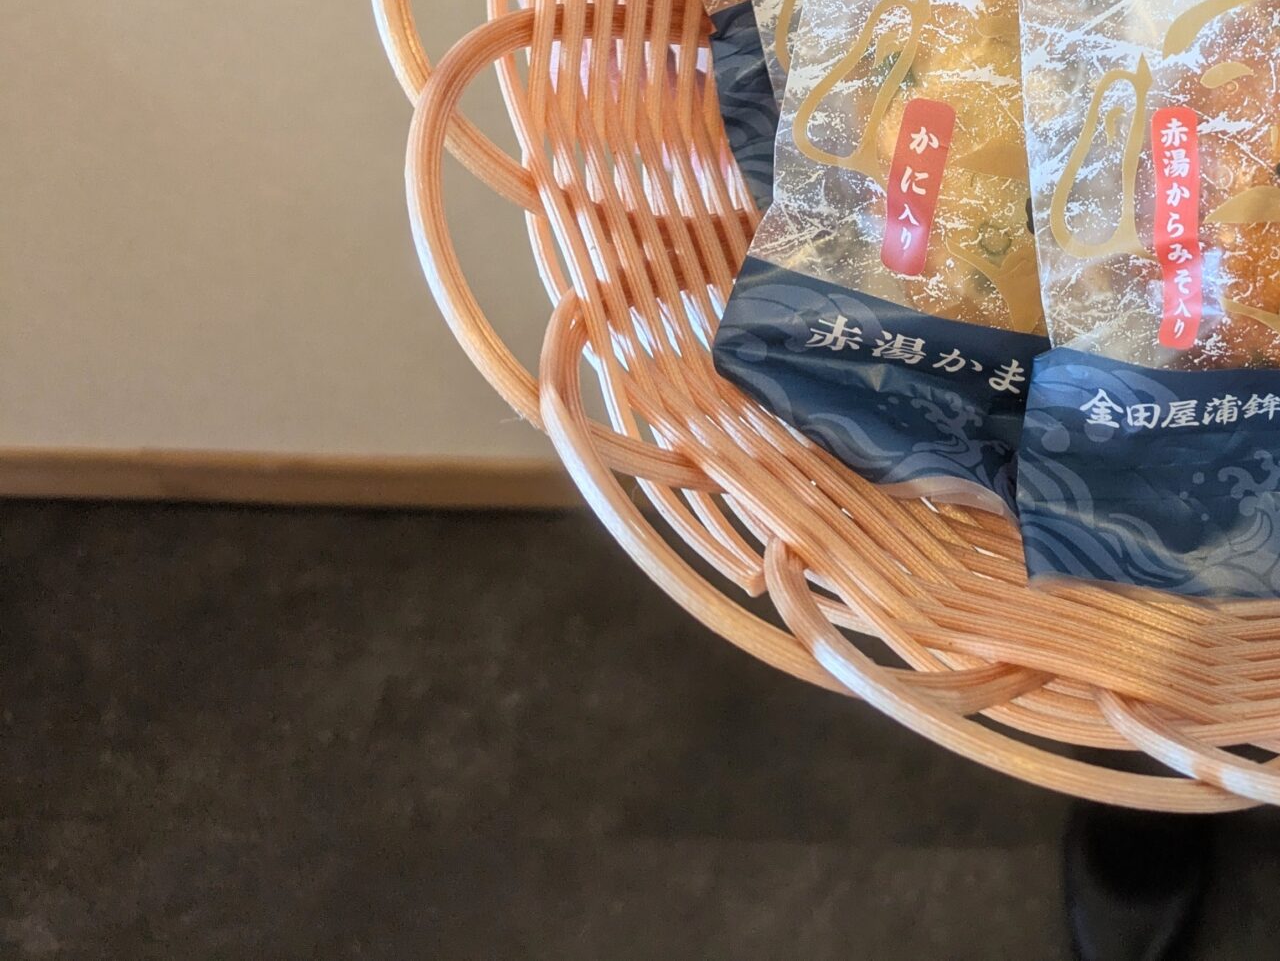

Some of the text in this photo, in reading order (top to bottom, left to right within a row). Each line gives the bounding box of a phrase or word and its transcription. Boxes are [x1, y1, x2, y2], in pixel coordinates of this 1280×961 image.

[899, 126, 939, 251] かに入り
[1160, 118, 1195, 337] 赤湯からみそ入り
[805, 314, 1026, 395] 赤湯かま
